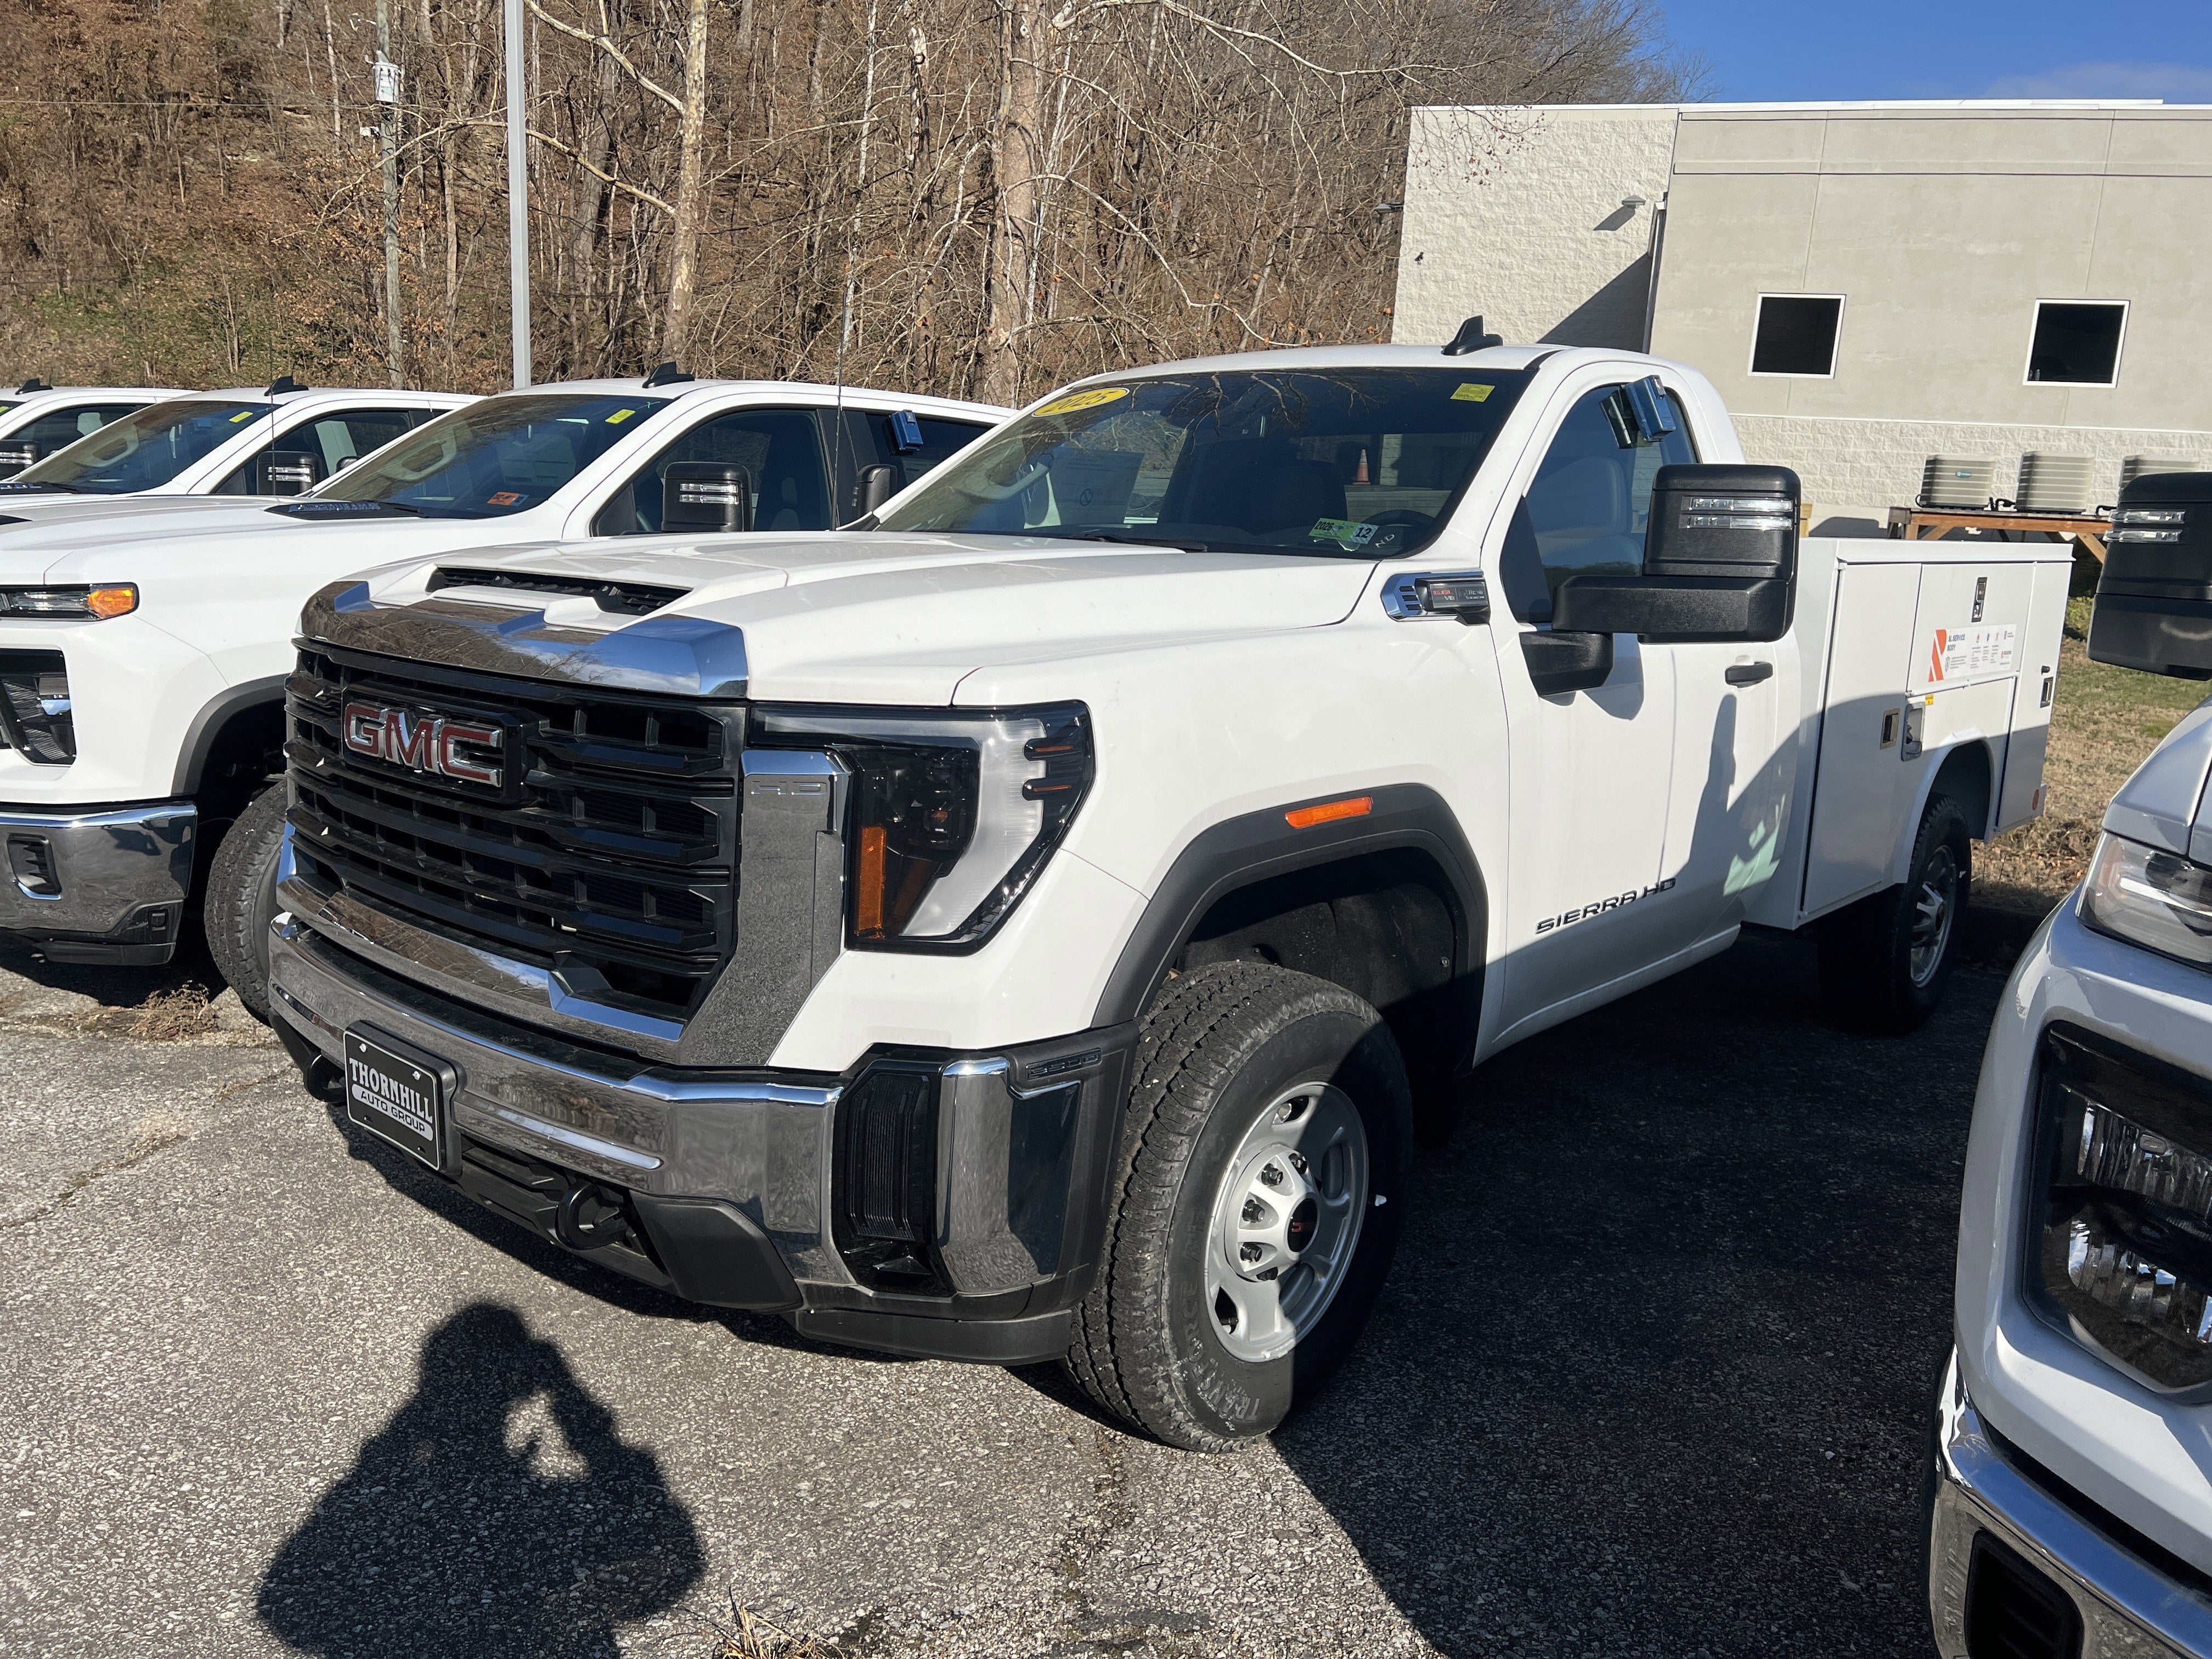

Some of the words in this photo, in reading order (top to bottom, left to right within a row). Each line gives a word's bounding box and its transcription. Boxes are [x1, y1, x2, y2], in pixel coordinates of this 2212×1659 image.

[1314, 521, 1335, 531] 2026
[1355, 527, 1373, 539] 12
[345, 702, 503, 788] GMC
[751, 780, 828, 796] HD
[1535, 889, 1638, 935] SIERRA
[1641, 877, 1677, 899] HD
[349, 1057, 433, 1124] THORNHILL
[360, 1090, 388, 1112] AUTO
[391, 1105, 425, 1132] GROUP
